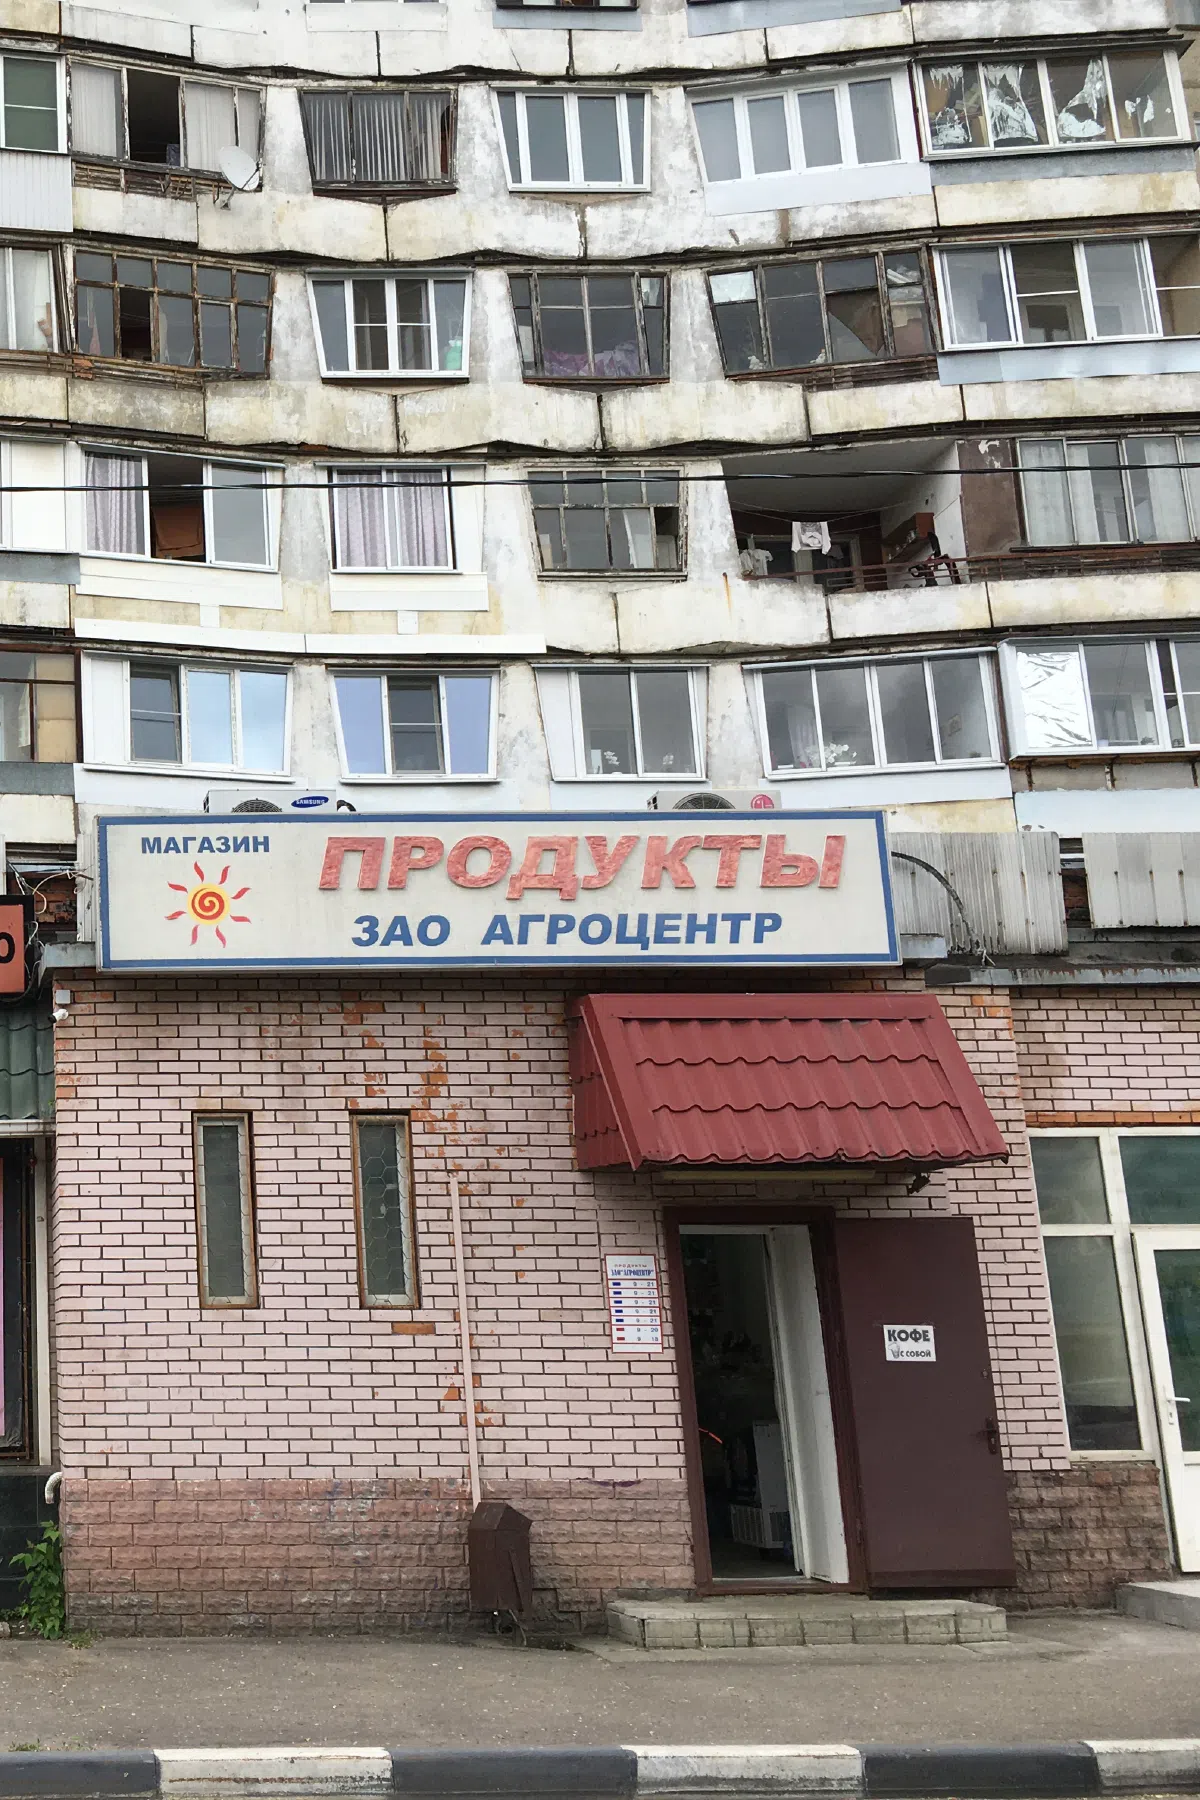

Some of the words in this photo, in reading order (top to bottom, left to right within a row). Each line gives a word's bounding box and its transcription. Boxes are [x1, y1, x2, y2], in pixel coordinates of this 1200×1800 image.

[140, 836, 271, 855] МАГАЗИН
[318, 834, 844, 901] ПРОДУКТЫ
[352, 914, 451, 947] ЗАО
[480, 912, 784, 951] АГРОЦЕНТР
[888, 1328, 930, 1343] КОФЕ
